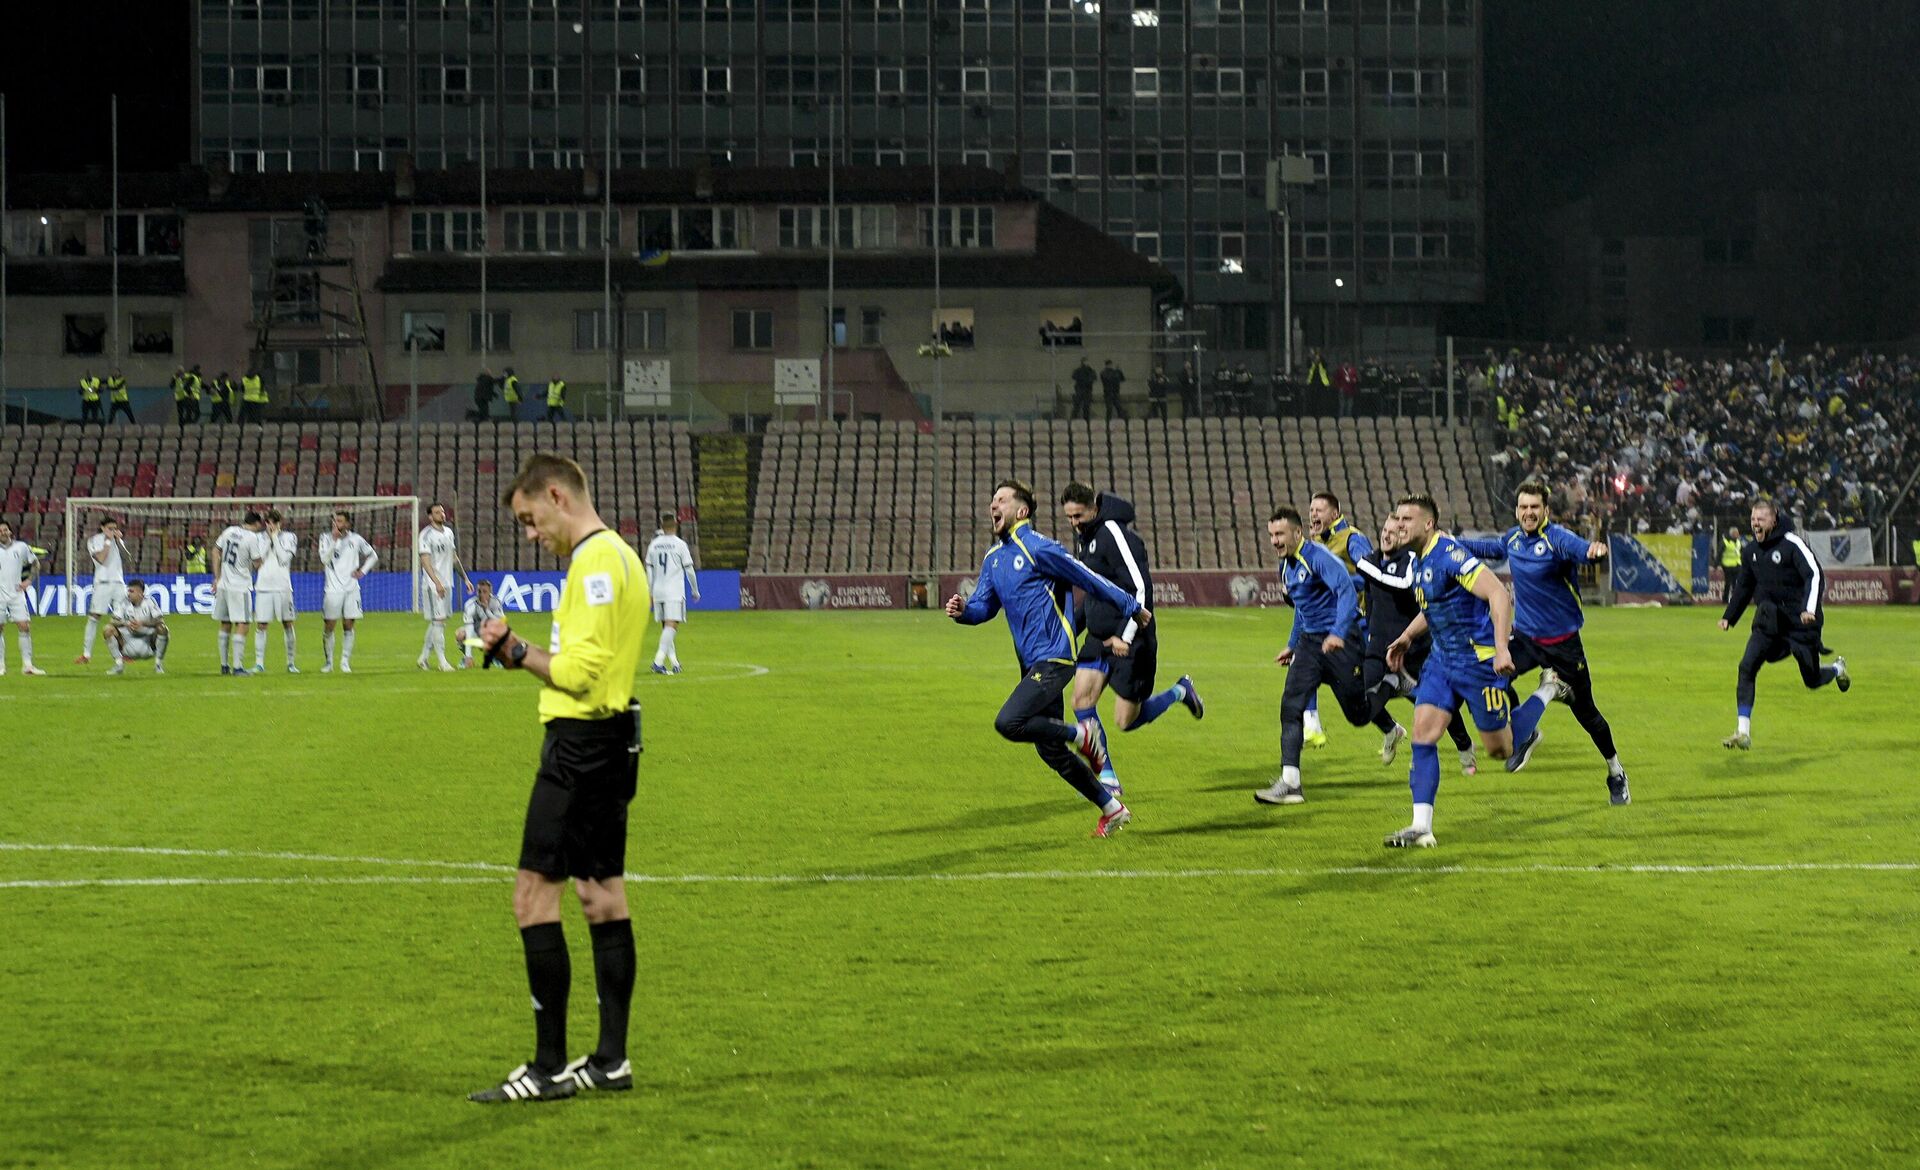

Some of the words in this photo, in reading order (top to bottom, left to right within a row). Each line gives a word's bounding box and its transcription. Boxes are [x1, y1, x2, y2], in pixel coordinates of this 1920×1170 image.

[223, 540, 239, 568] 15
[658, 552, 668, 575] 4
[497, 573, 566, 612] An
[836, 586, 887, 597] EUROPEAN
[1834, 580, 1884, 591] EUROPEAN
[831, 595, 893, 608] QUALIFIERS
[1828, 589, 1889, 602] QUALIFIERS
[1481, 686, 1504, 712] 10
